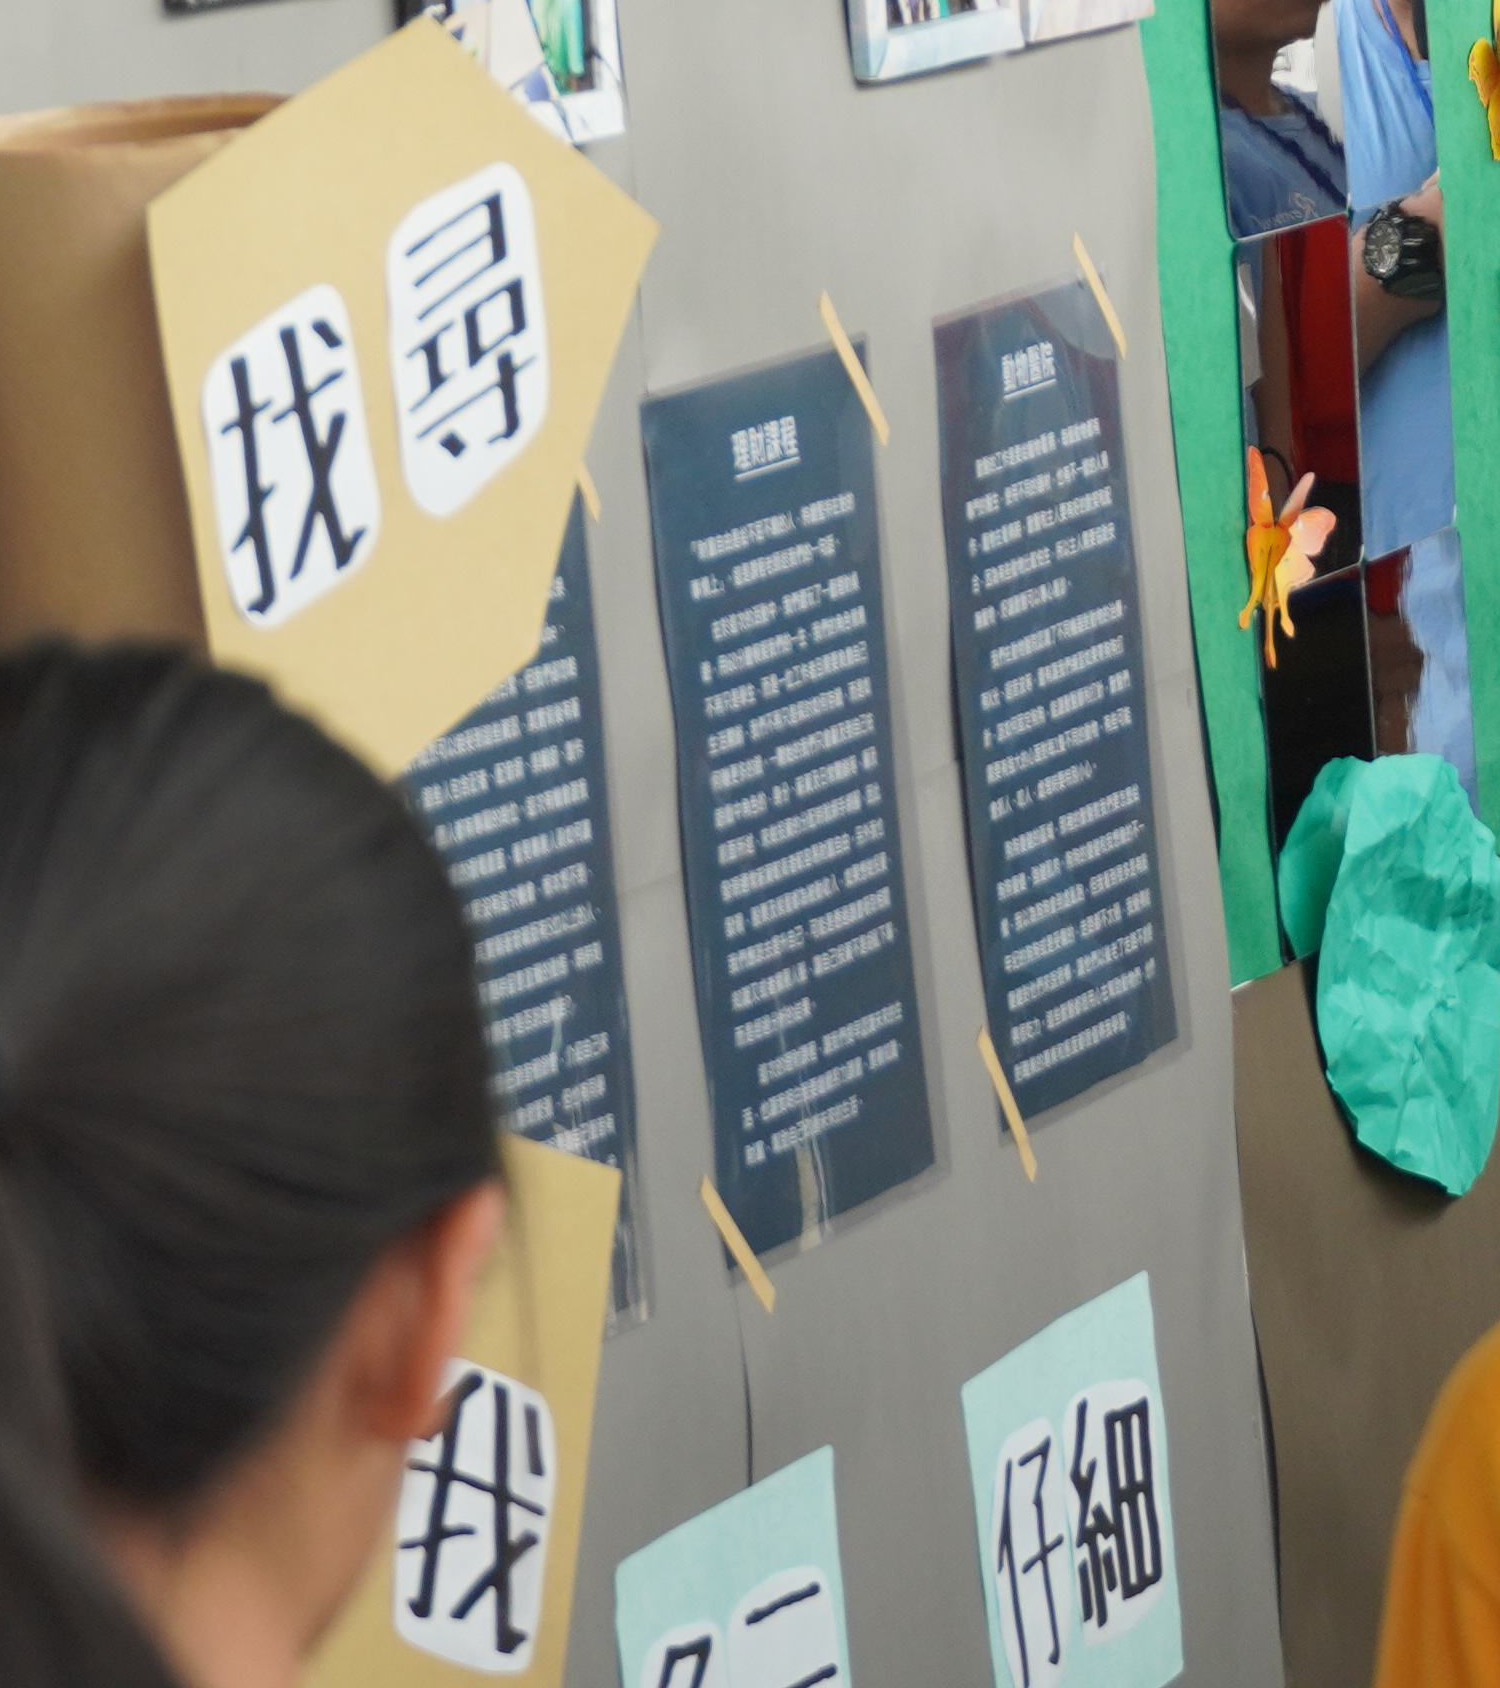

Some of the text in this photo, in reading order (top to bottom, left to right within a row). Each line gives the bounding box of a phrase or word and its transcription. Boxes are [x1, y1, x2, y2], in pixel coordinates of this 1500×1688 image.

[731, 415, 800, 471] 理財課程
[997, 1394, 1164, 1688] 仔細
